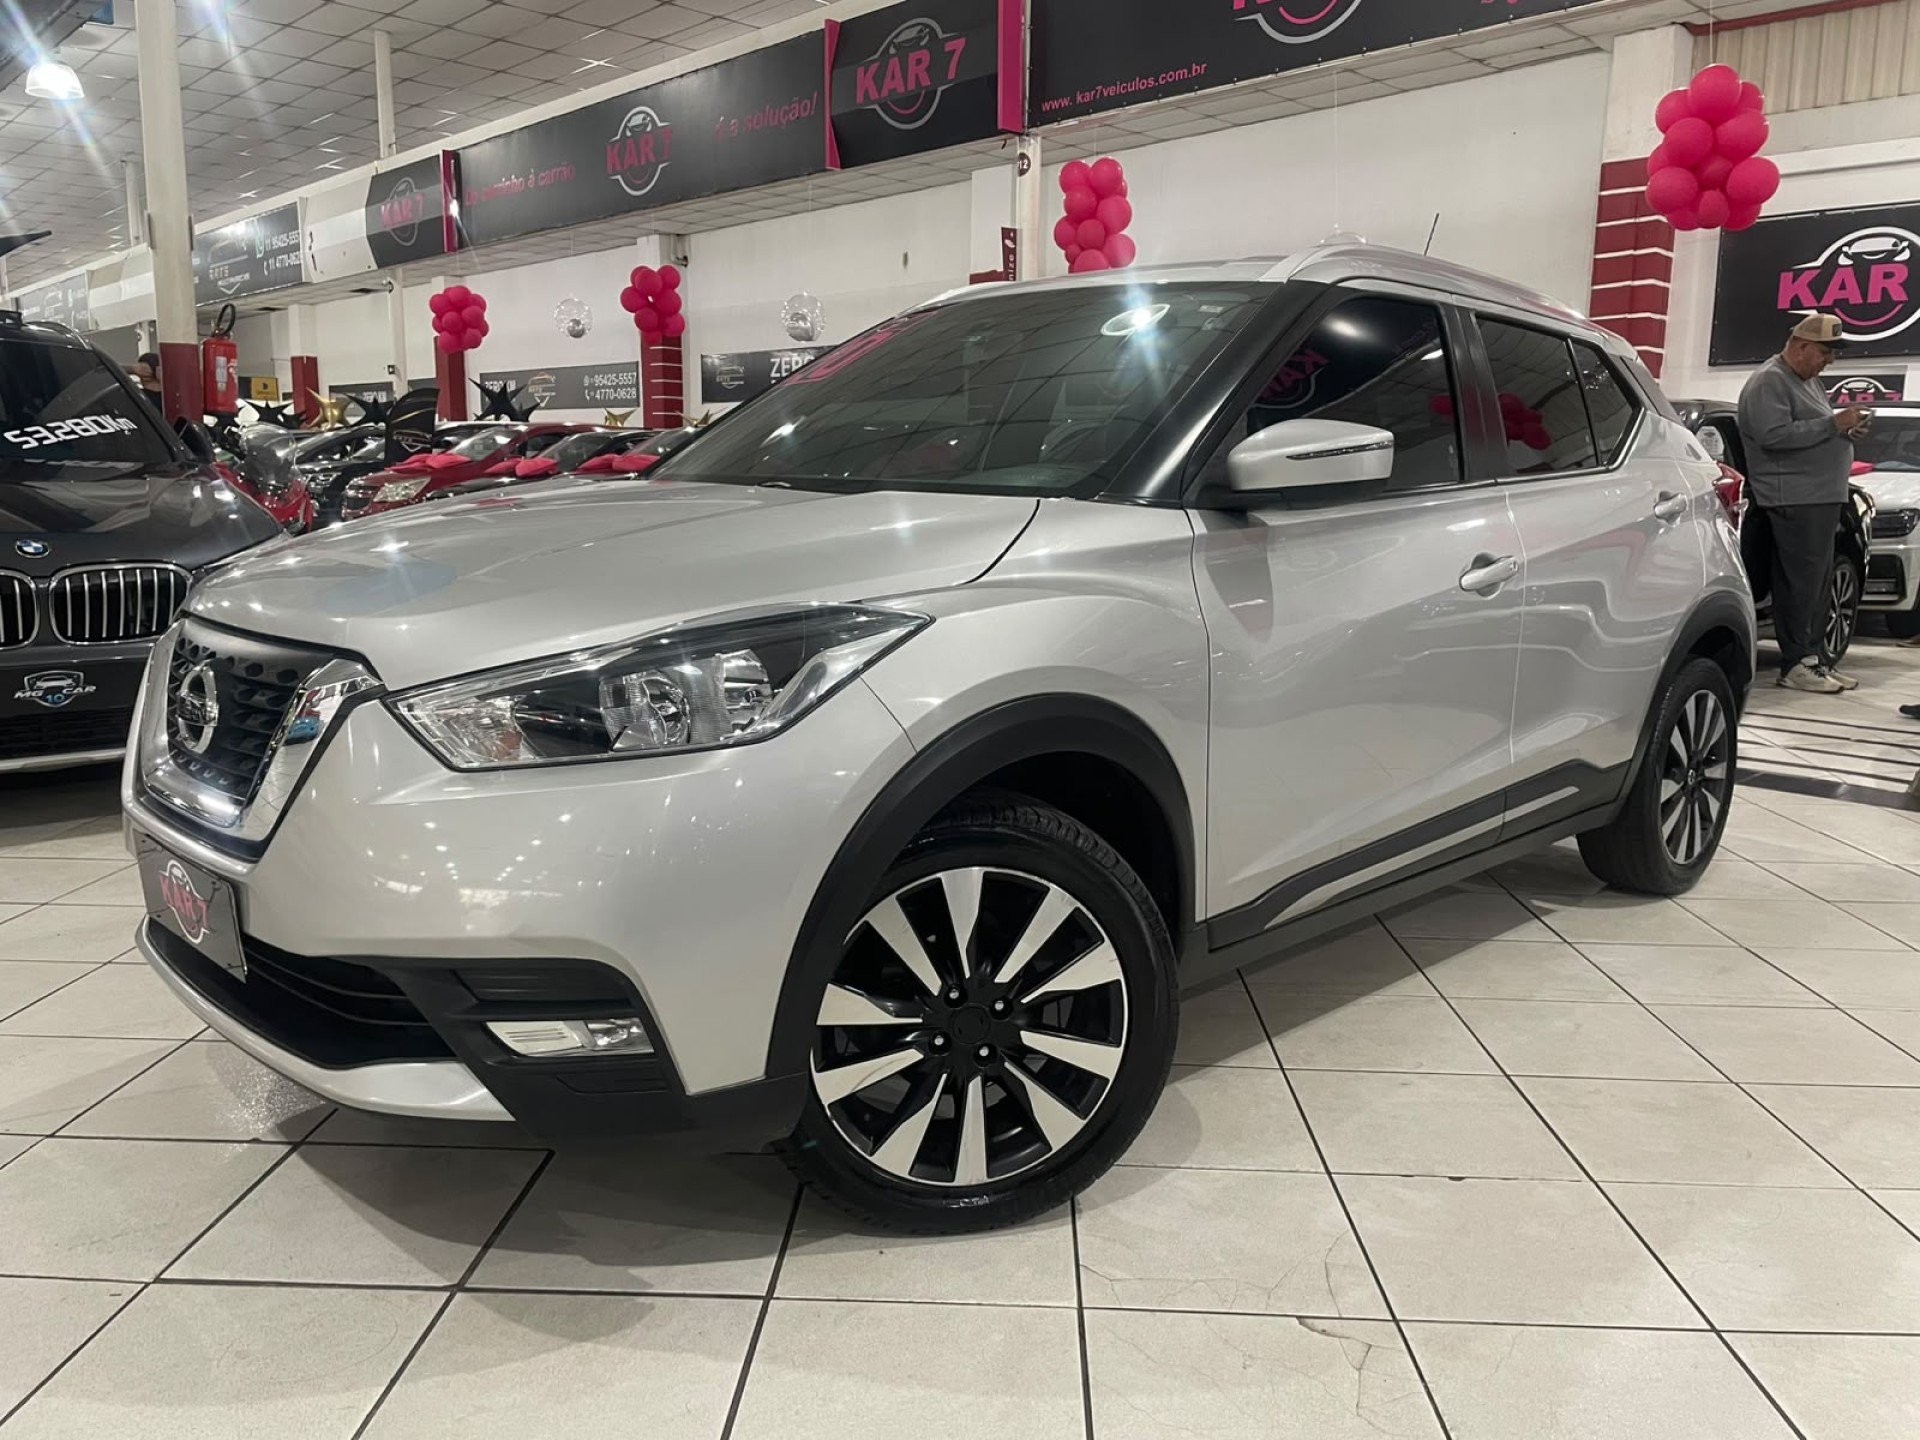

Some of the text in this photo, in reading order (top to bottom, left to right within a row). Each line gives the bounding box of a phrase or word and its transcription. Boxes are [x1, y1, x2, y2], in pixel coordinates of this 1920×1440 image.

[856, 37, 966, 105] KAR 7
[1041, 62, 1208, 113] www. kar7veiculos.com.br
[744, 90, 818, 134] solução!
[606, 127, 673, 174] KAR 7
[1777, 263, 1909, 309] KAR
[1827, 392, 1875, 404] AR
[46, 692, 66, 703] 10
[62, 685, 97, 695] CAR
[160, 874, 209, 928] KAR 7
